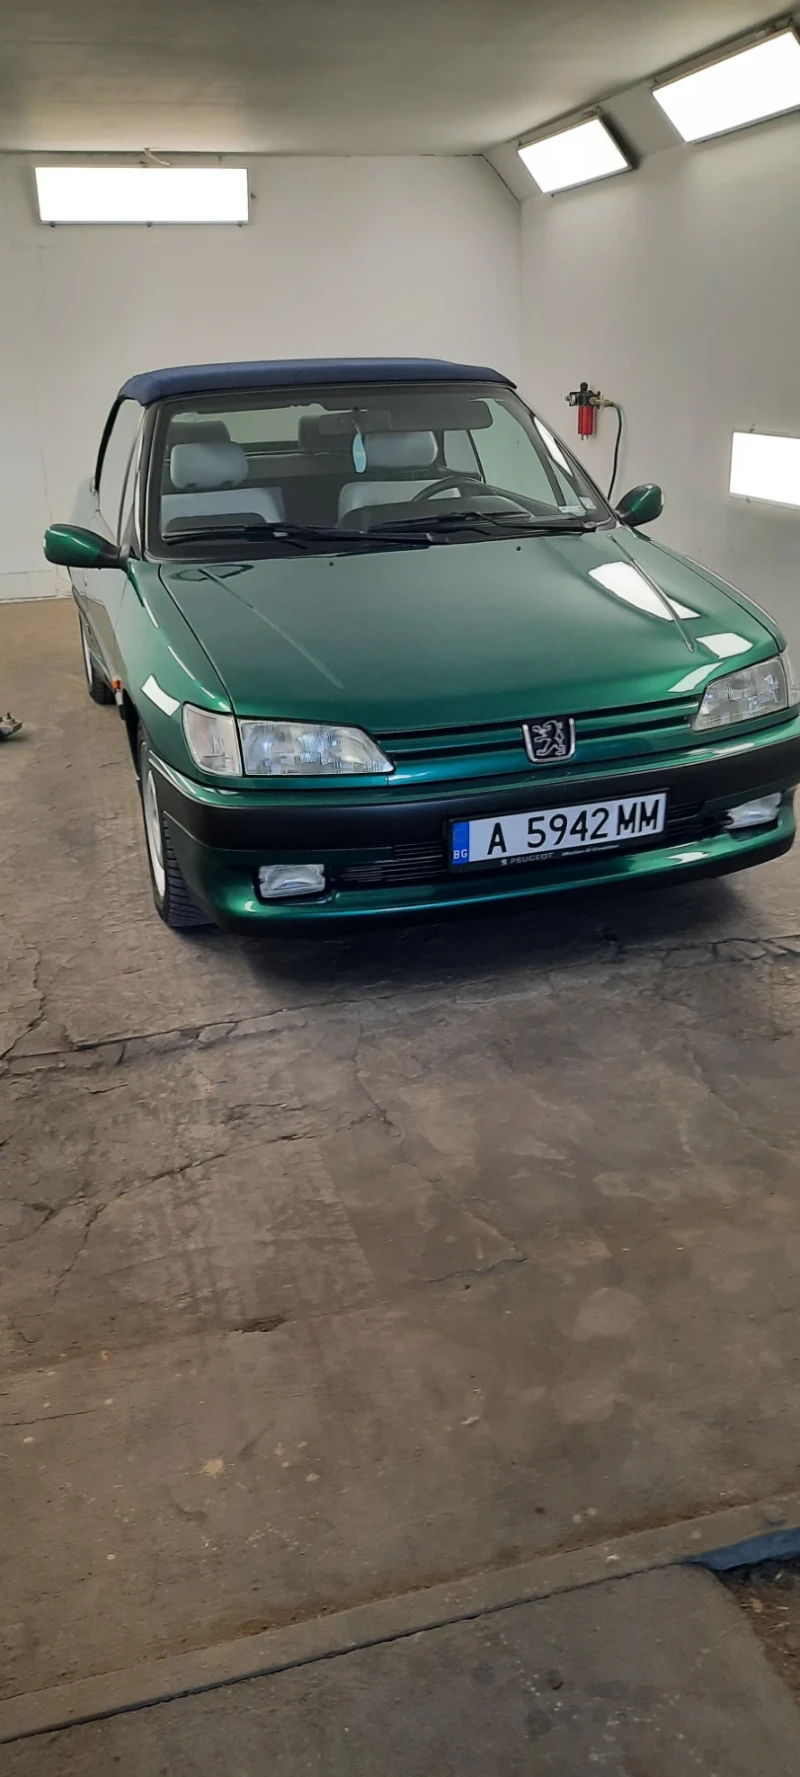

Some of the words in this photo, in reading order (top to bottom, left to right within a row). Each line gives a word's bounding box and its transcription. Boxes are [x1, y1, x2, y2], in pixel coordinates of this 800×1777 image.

[487, 822, 507, 855] A
[527, 807, 610, 849] 5942
[616, 799, 660, 836] MM
[453, 849, 468, 860] BG
[510, 852, 553, 865] PEUGEOT
